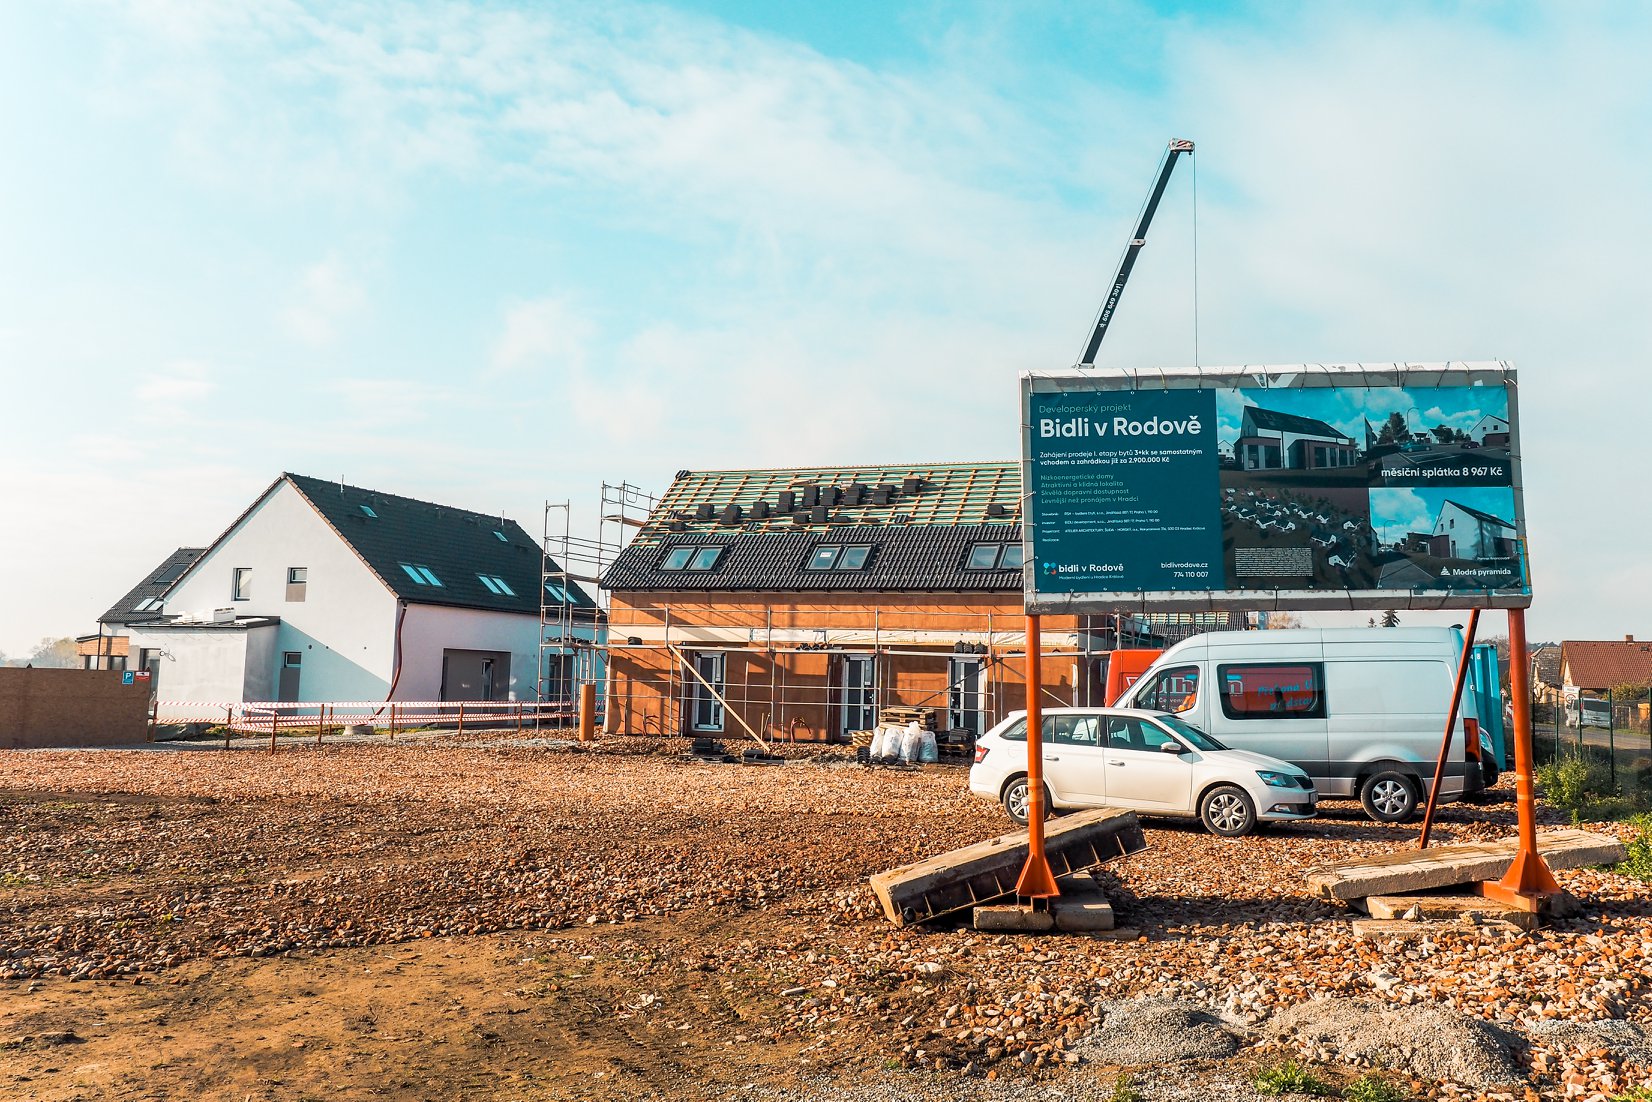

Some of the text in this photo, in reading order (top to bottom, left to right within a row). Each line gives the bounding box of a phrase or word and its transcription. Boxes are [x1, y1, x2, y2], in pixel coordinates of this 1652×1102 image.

[1039, 403, 1132, 414] Developerský projekt
[1040, 415, 1202, 438] Bidli v Rodově
[1039, 451, 1067, 459] Zahájení
[1068, 451, 1093, 459] prodeje
[1099, 450, 1118, 458] etapy
[1118, 449, 1133, 457] bytů
[1159, 448, 1203, 456] samostatným
[1111, 457, 1119, 465] již
[1381, 466, 1503, 478] měsíční splátka 8 967 Kč
[1040, 474, 1095, 482] Nízkoenergetické
[1058, 564, 1079, 573] bidli
[1089, 563, 1124, 572] Rodově
[1452, 568, 1512, 577] Modrá pyramida
[125, 672, 132, 680] P
